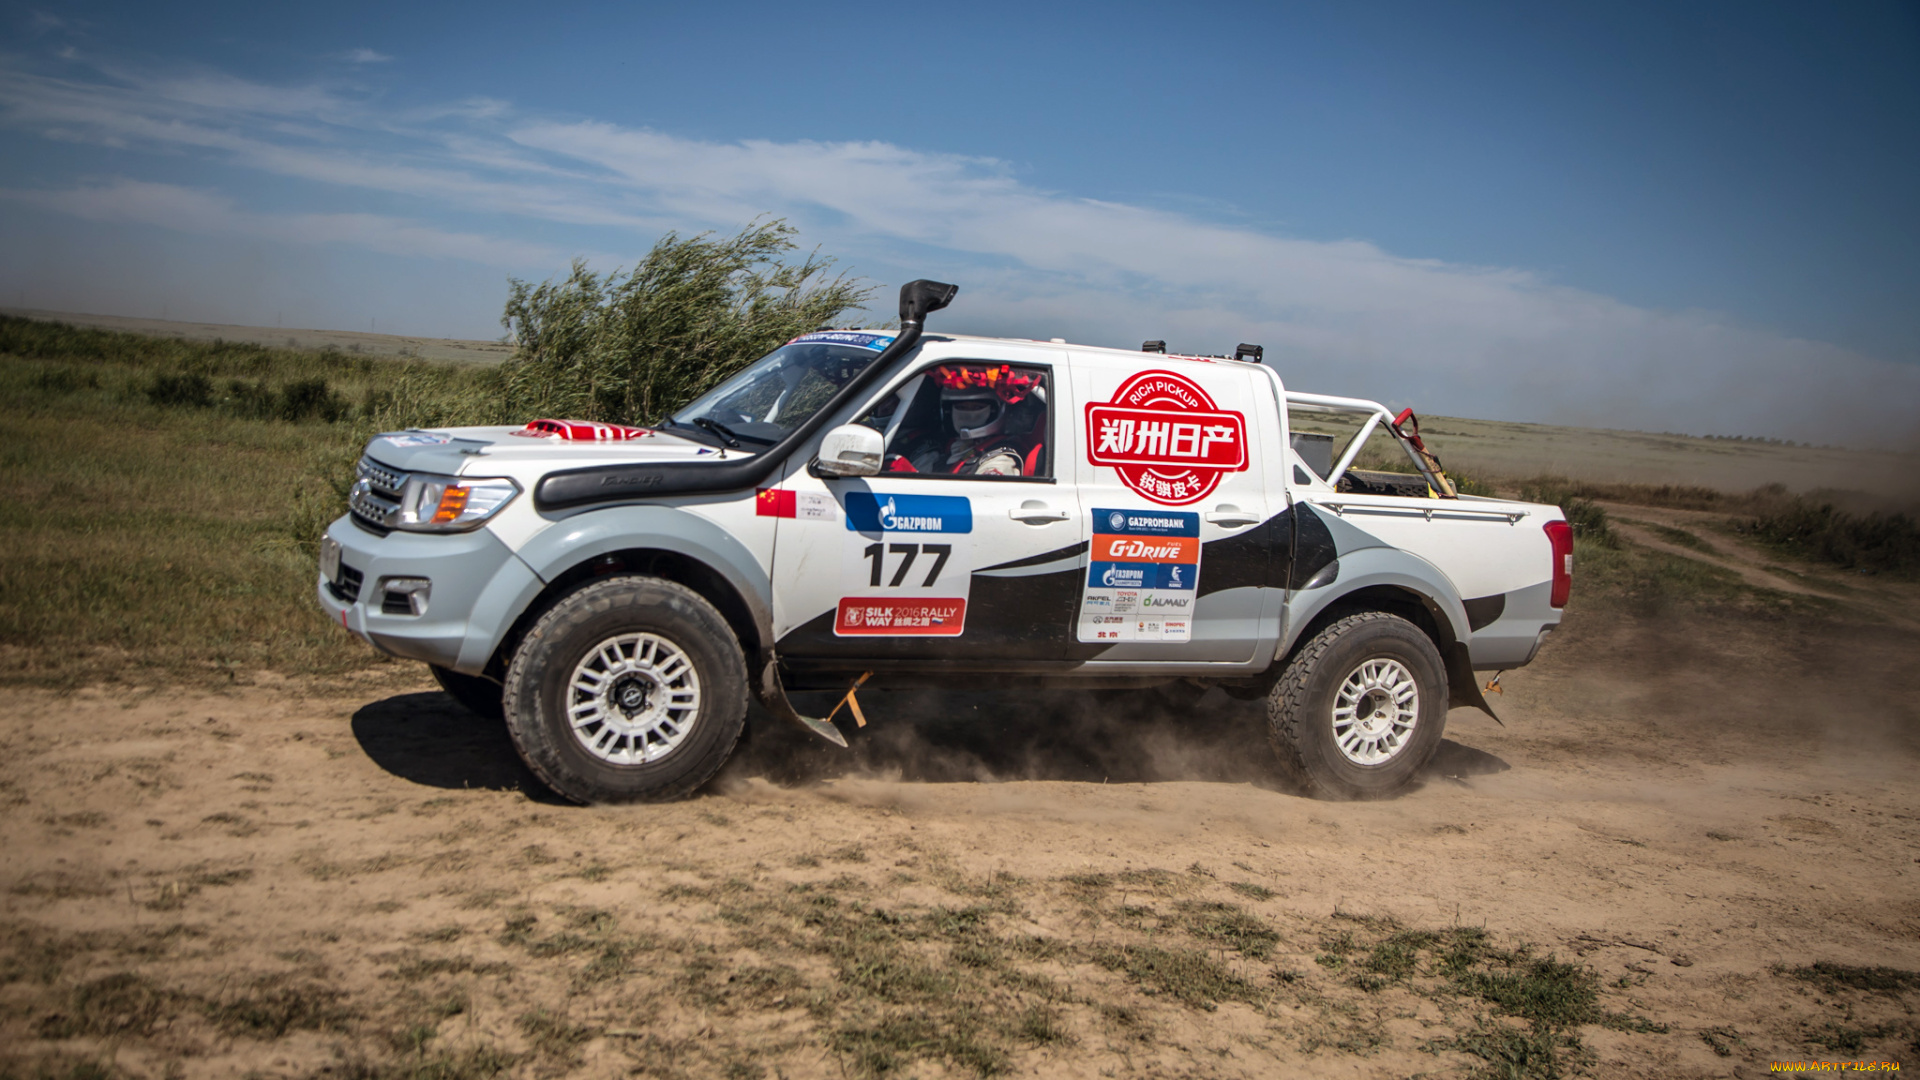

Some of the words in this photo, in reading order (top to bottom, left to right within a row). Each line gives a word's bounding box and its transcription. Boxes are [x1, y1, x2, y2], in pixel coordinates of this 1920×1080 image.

[1129, 382, 1156, 406] RICH
[1156, 381, 1199, 409] PICKUP
[1096, 417, 1236, 459] 郑州日产
[1138, 471, 1203, 499] 锐骐皮卡
[897, 516, 942, 531] GAZPROM
[1128, 517, 1184, 529] GAZPROMBANK
[863, 543, 953, 588] 177
[1114, 569, 1144, 580] ГАЗПРОМ
[1152, 597, 1190, 608] ALMALY
[866, 606, 894, 617] SILK
[894, 607, 920, 617] 2016
[920, 607, 958, 618] RALLY
[865, 616, 892, 627] WAY
